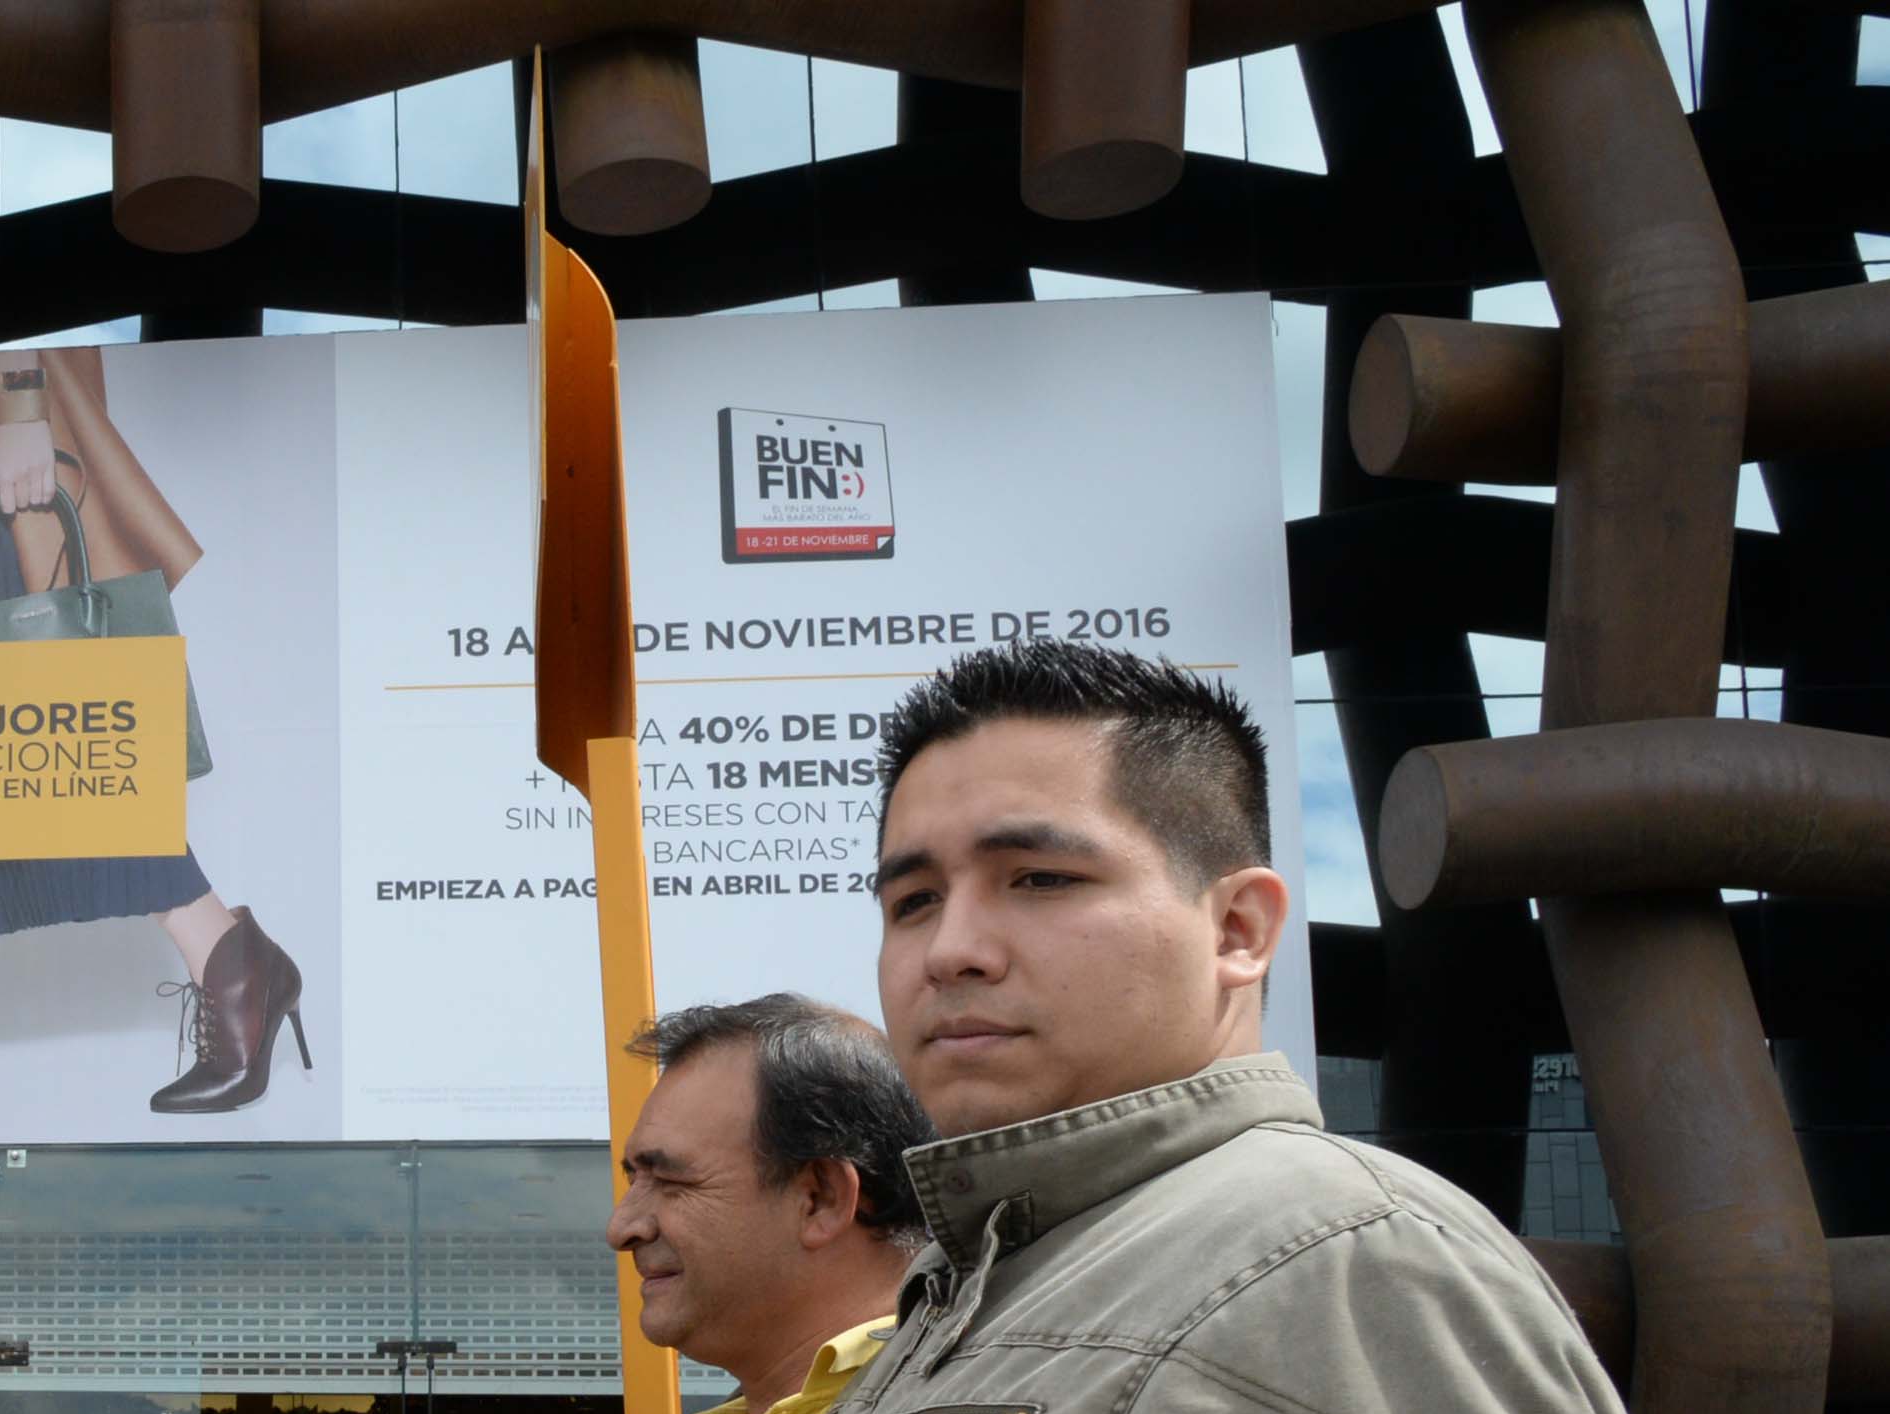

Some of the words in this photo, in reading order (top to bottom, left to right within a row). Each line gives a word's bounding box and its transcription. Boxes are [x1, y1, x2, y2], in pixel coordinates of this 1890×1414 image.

[756, 434, 864, 468] BUEN
[746, 536, 758, 547] 18
[783, 535, 798, 546] DE
[801, 534, 869, 545] NOVIEMBRE
[447, 627, 489, 657] 18
[504, 626, 534, 656] A
[633, 622, 690, 652] DE
[705, 613, 976, 650] NOVIEMBRE
[991, 610, 1051, 642] DE
[1067, 607, 1170, 640] 2016
[678, 715, 770, 744] 40%
[781, 713, 837, 741] DE
[3, 778, 41, 798] EN
[52, 772, 138, 798] LÍNEA
[706, 761, 747, 789] 18
[759, 758, 876, 788] MENS
[505, 806, 556, 830] SIN
[567, 803, 744, 829] INRESES
[755, 801, 826, 825] CON
[837, 800, 880, 823] TA
[376, 879, 505, 900] EMPIEZA
[513, 878, 535, 898] A
[543, 878, 597, 898] PAG
[653, 875, 692, 897] EN
[701, 874, 791, 895] ABRIL
[799, 873, 839, 894] DE
